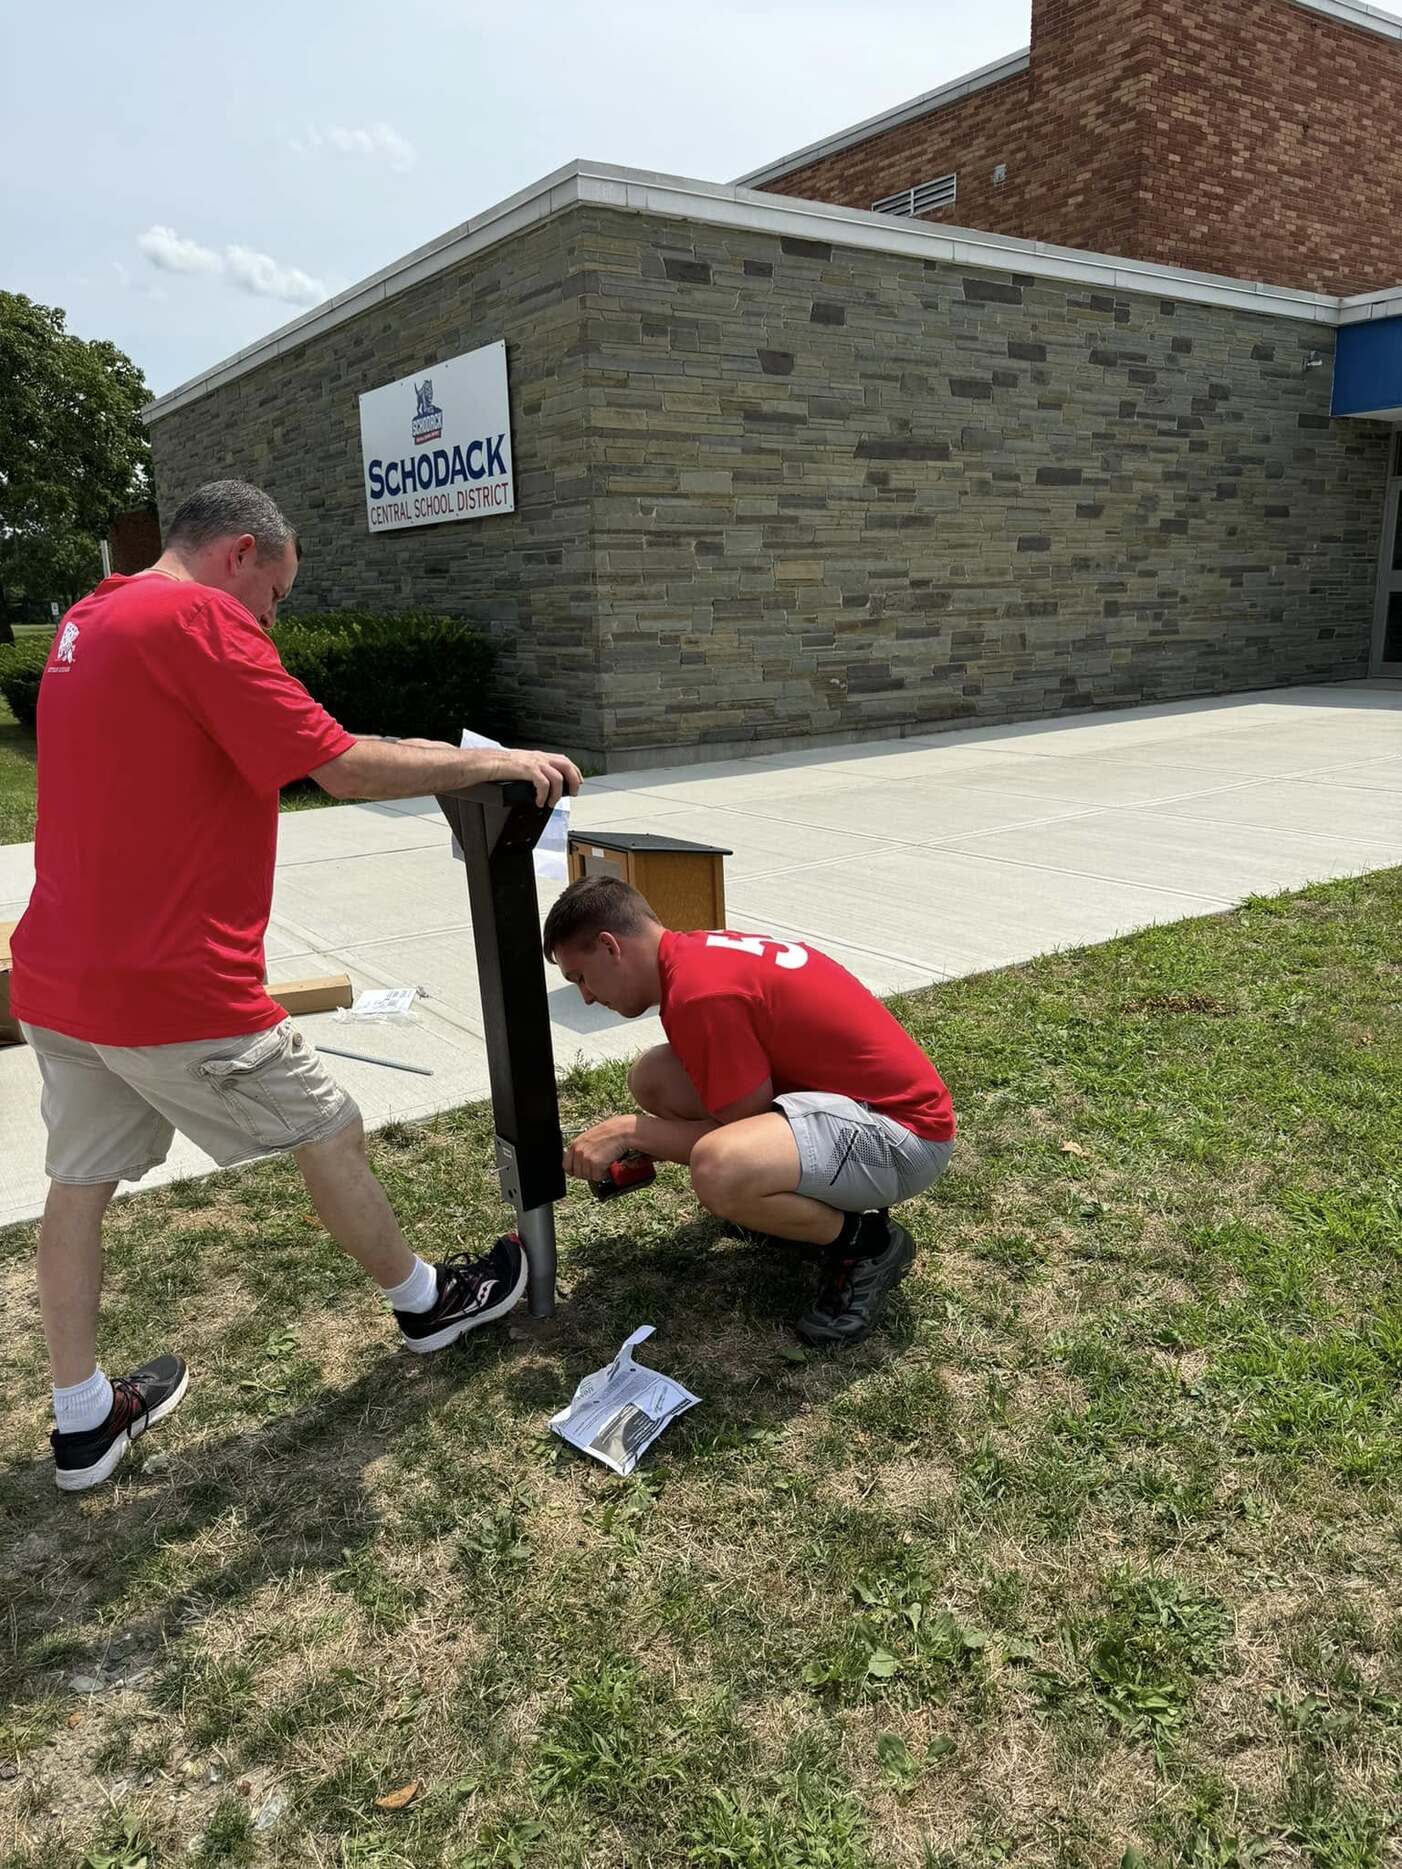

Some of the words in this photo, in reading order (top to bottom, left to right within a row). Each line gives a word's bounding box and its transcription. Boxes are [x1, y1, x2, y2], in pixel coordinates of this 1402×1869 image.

[368, 433, 507, 499] SCHODACK
[370, 503, 412, 526] CENTRAL
[414, 492, 454, 519] SCHOOL
[457, 482, 509, 512] DISTRICT
